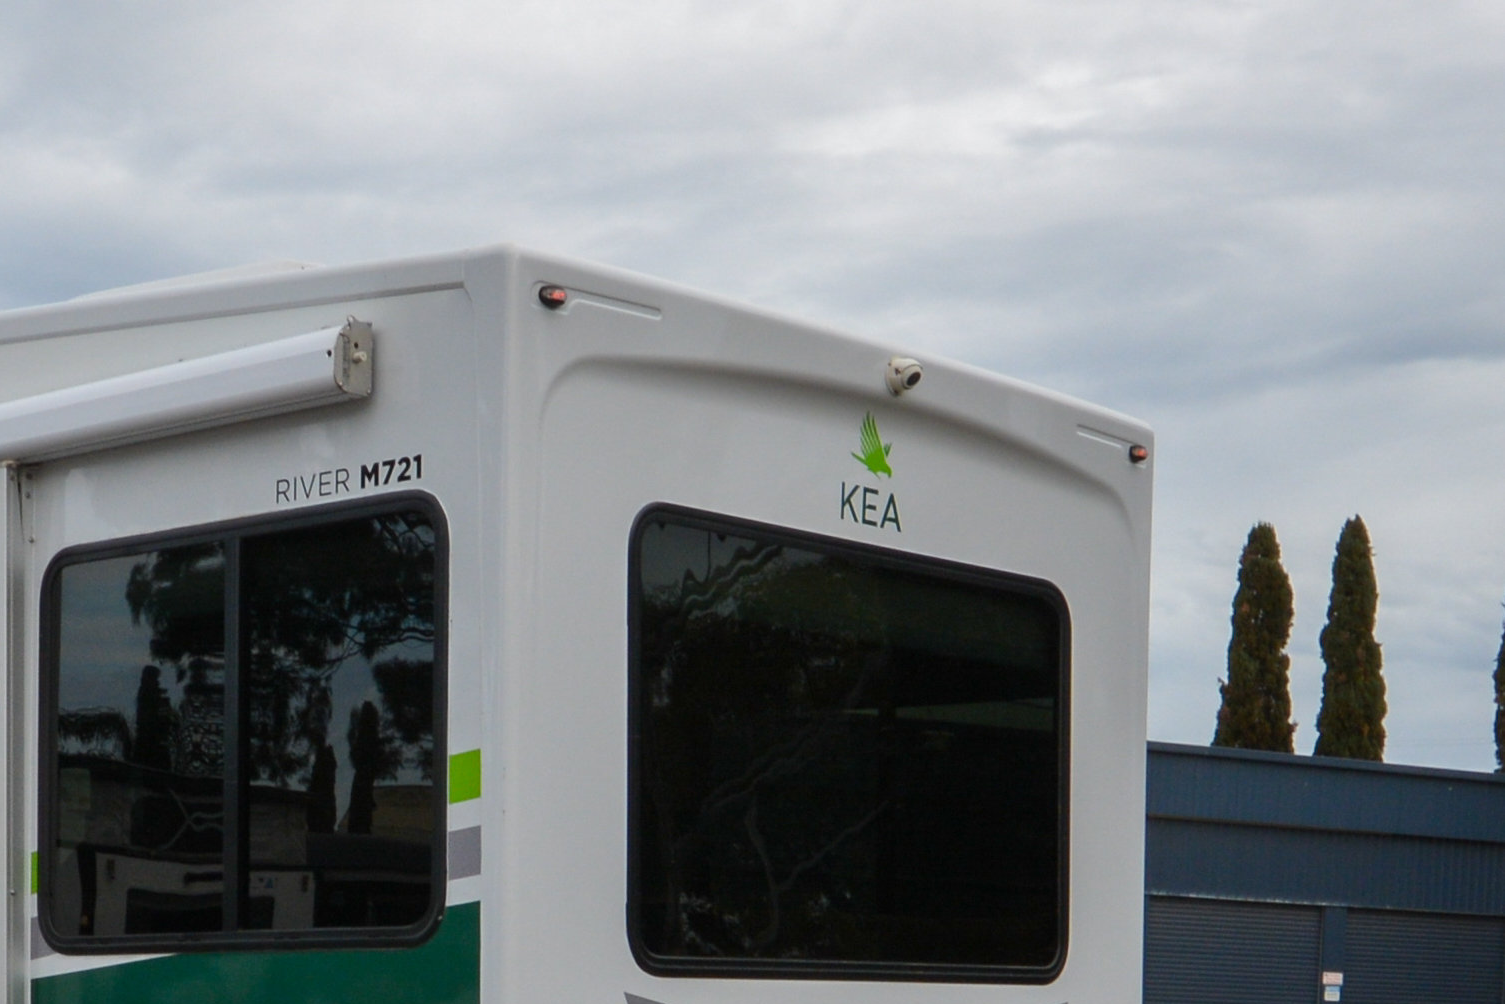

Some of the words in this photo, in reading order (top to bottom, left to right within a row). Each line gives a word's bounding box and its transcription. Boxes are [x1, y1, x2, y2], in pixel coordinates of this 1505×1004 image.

[275, 467, 350, 504] RIVER
[360, 453, 423, 489] M721
[839, 481, 902, 533] KEA
